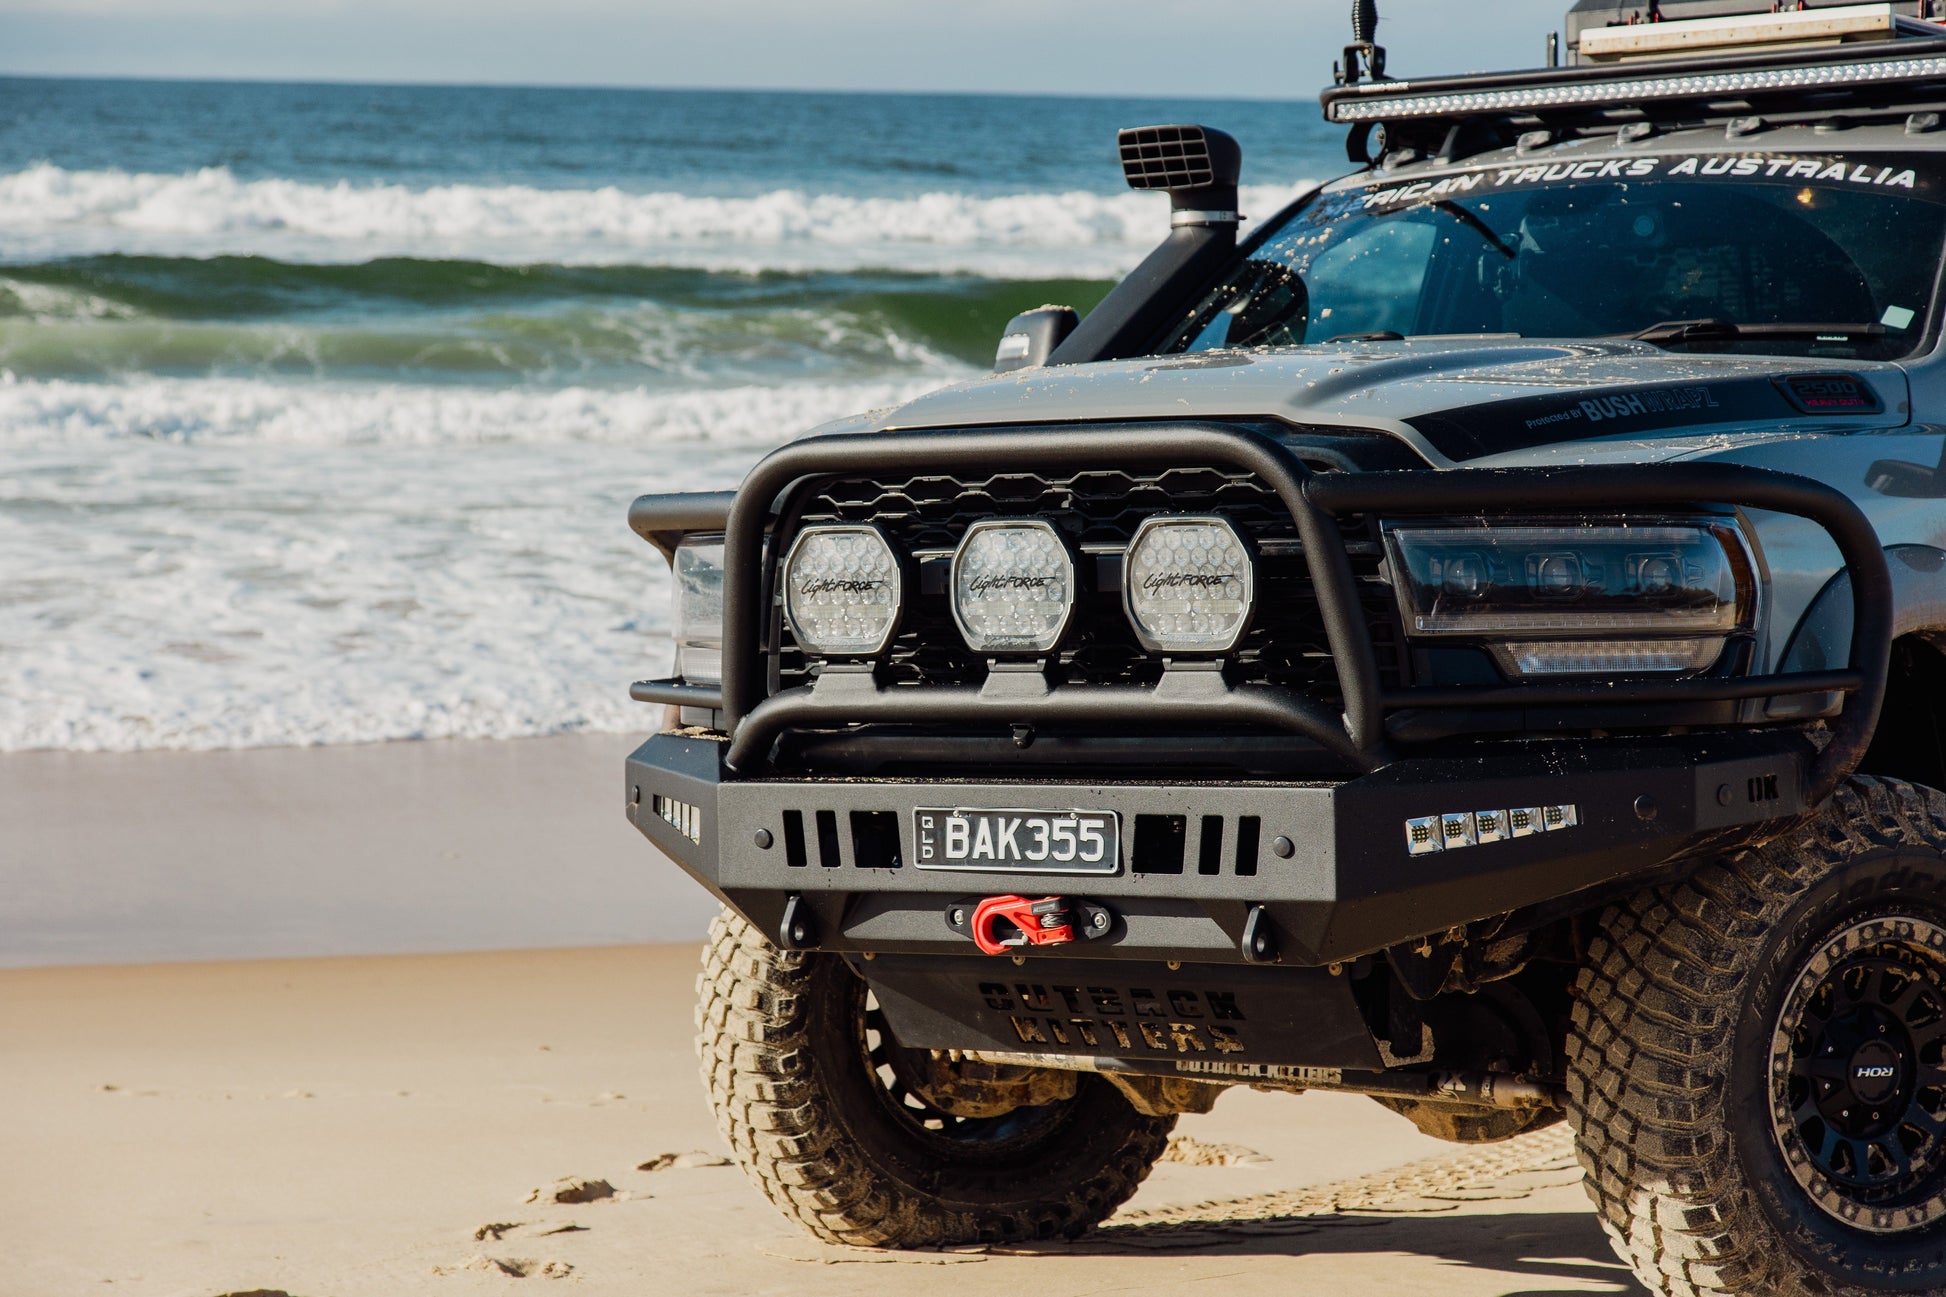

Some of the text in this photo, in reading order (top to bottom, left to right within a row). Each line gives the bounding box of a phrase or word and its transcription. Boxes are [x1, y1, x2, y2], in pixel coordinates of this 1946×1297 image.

[1495, 158, 1659, 186] TRUCKS
[1667, 157, 1917, 188] AUSTRALIA
[1797, 382, 1857, 394] 2500
[1525, 411, 1570, 430] Protected
[922, 816, 934, 859] QLD
[945, 816, 1105, 862] BAK355
[979, 982, 1247, 1021] OUTBACK
[1857, 1067, 1894, 1077] ROH
